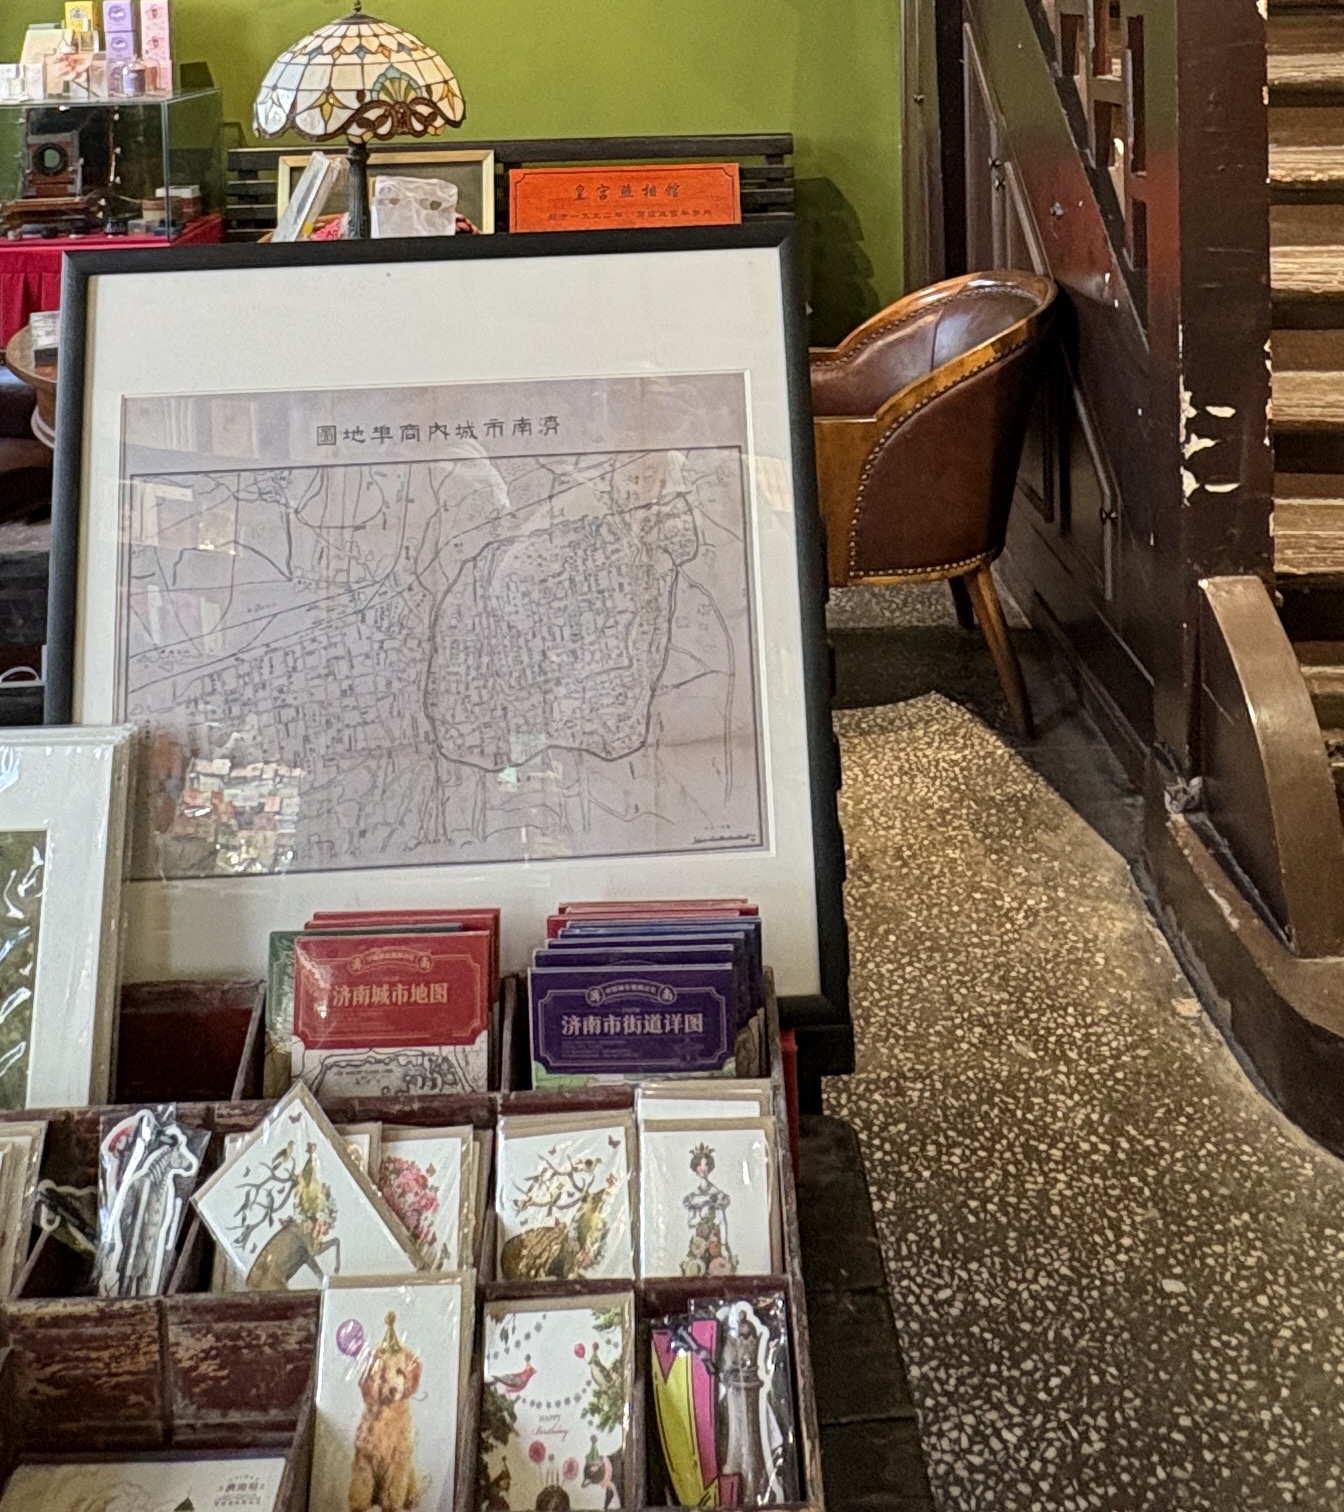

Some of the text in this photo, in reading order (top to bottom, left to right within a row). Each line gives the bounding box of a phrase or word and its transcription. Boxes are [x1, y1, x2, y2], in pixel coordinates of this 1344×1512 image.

[333, 982, 449, 1007] 济南城市地图
[561, 1012, 703, 1036] 济南市街道详图
